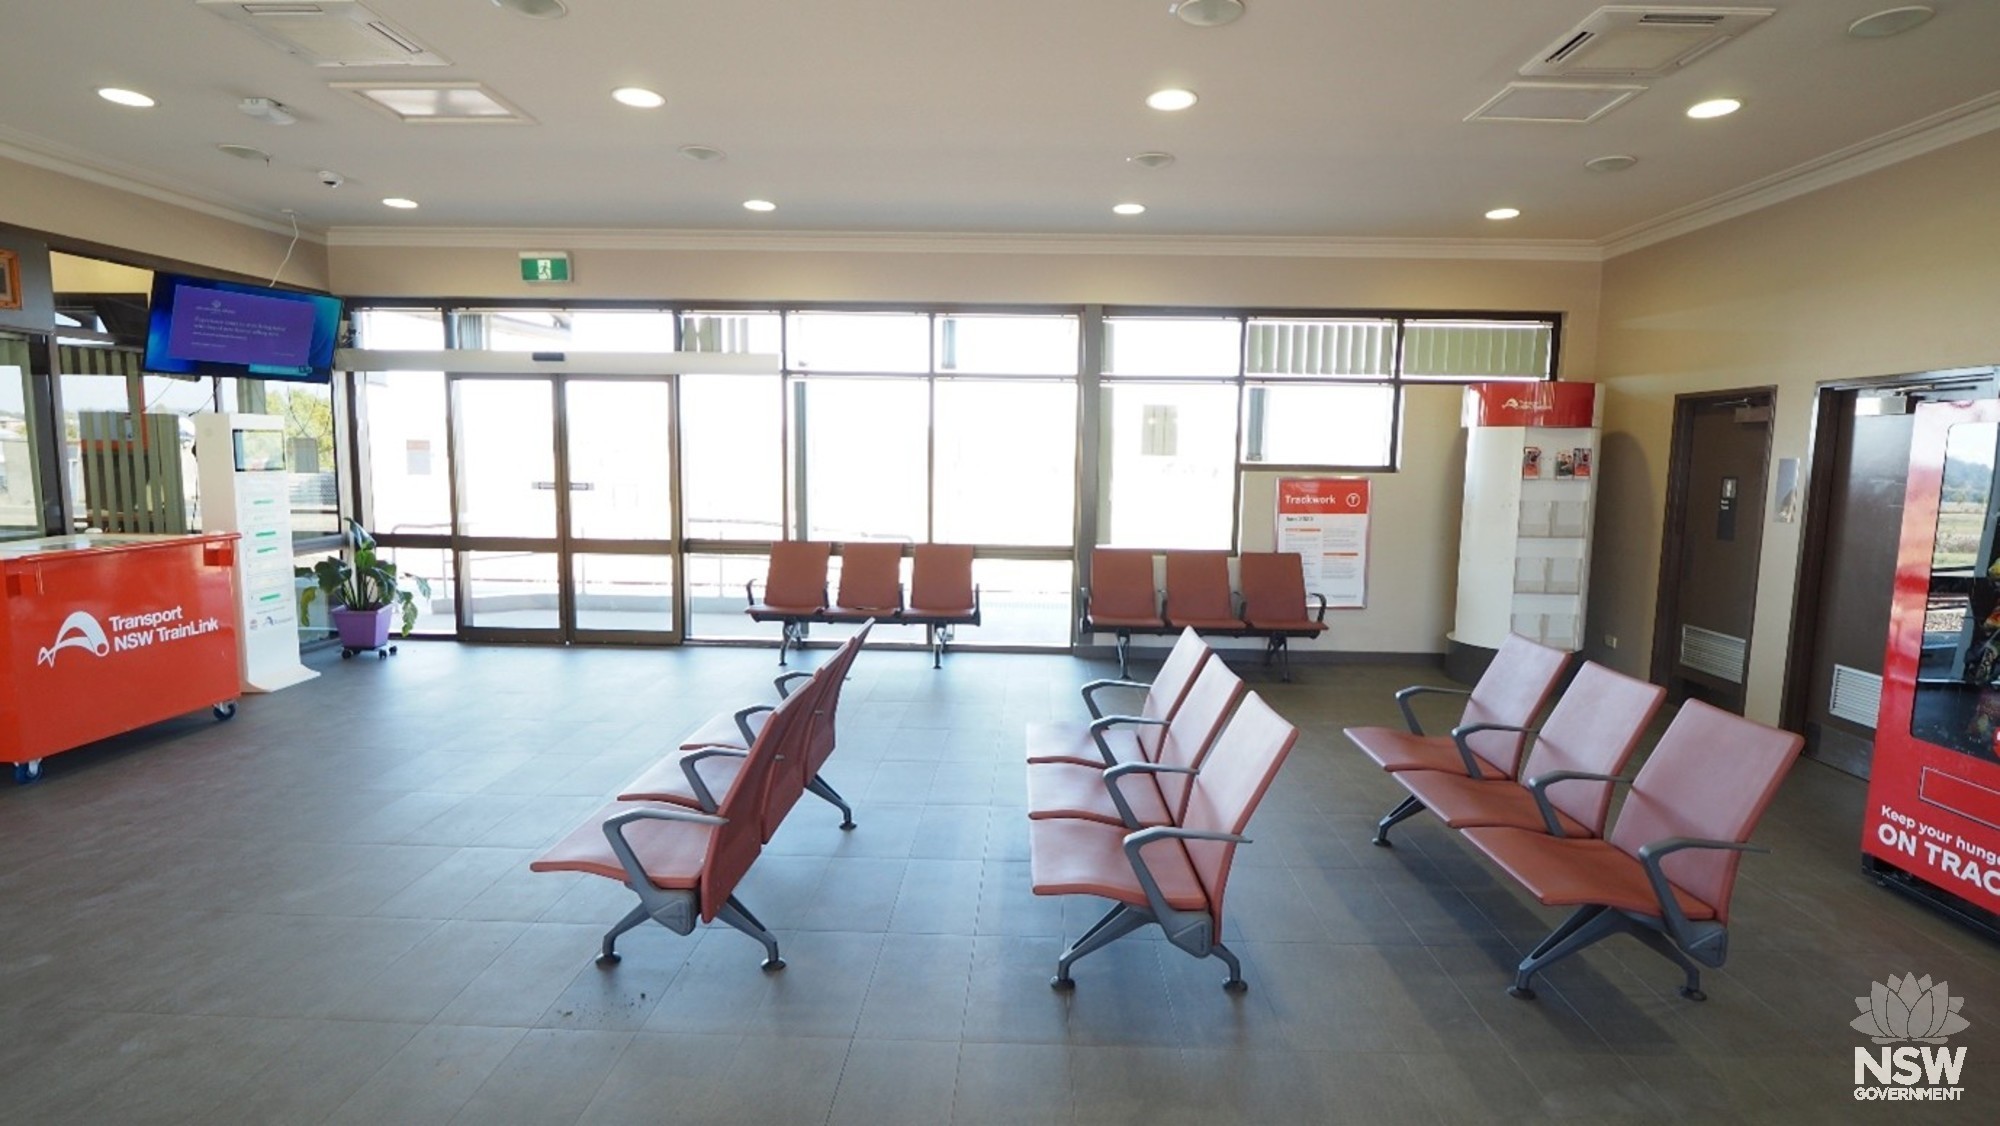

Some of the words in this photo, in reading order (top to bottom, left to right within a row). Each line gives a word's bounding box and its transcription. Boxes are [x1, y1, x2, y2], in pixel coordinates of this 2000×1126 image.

[1285, 494, 1336, 505] Trackwork
[108, 605, 183, 632] Transport
[114, 629, 154, 652] NSW
[156, 617, 219, 643] TrainLink
[1877, 823, 1917, 857] ON
[1881, 804, 1916, 830] Keep
[1918, 822, 1953, 844] your
